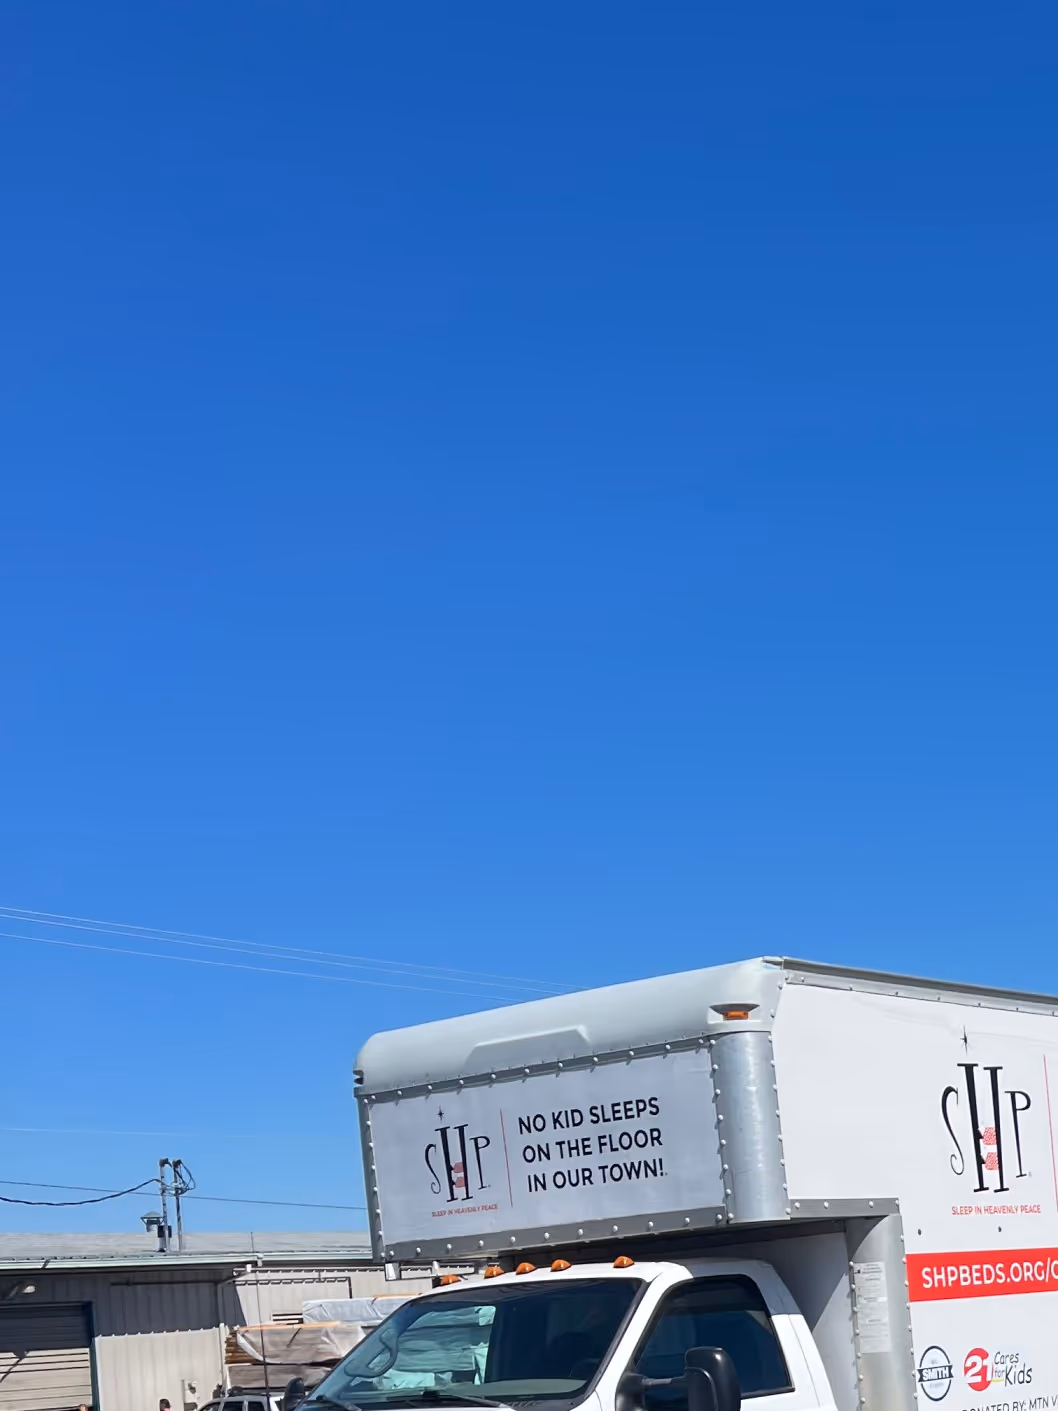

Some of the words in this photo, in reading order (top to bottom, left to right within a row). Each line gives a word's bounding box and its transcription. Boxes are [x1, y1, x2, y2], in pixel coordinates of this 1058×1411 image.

[518, 1114, 546, 1135] NO
[551, 1109, 584, 1130] KID
[589, 1097, 660, 1125] SLEEPS
[522, 1142, 551, 1163] ON
[555, 1137, 592, 1159] THE
[597, 1128, 663, 1154] FLOOR
[527, 1174, 547, 1192] IN
[552, 1167, 594, 1189] OUR
[598, 1158, 664, 1184] TOWN!
[431, 1210, 447, 1218] SLEEP
[454, 1206, 481, 1215] HEAVENLY
[481, 1204, 498, 1213] PEACE
[951, 1205, 973, 1216] SLEEP
[974, 1205, 982, 1215] IN
[984, 1205, 1019, 1215] HEAVENLY
[1020, 1204, 1041, 1214] PEACE
[993, 1351, 1020, 1365] Cares
[922, 1367, 950, 1381] SMITH
[964, 1355, 993, 1384] 21
[993, 1366, 1005, 1379] for
[1004, 1362, 1033, 1387] Kids
[1029, 1396, 1049, 1410] MTN
